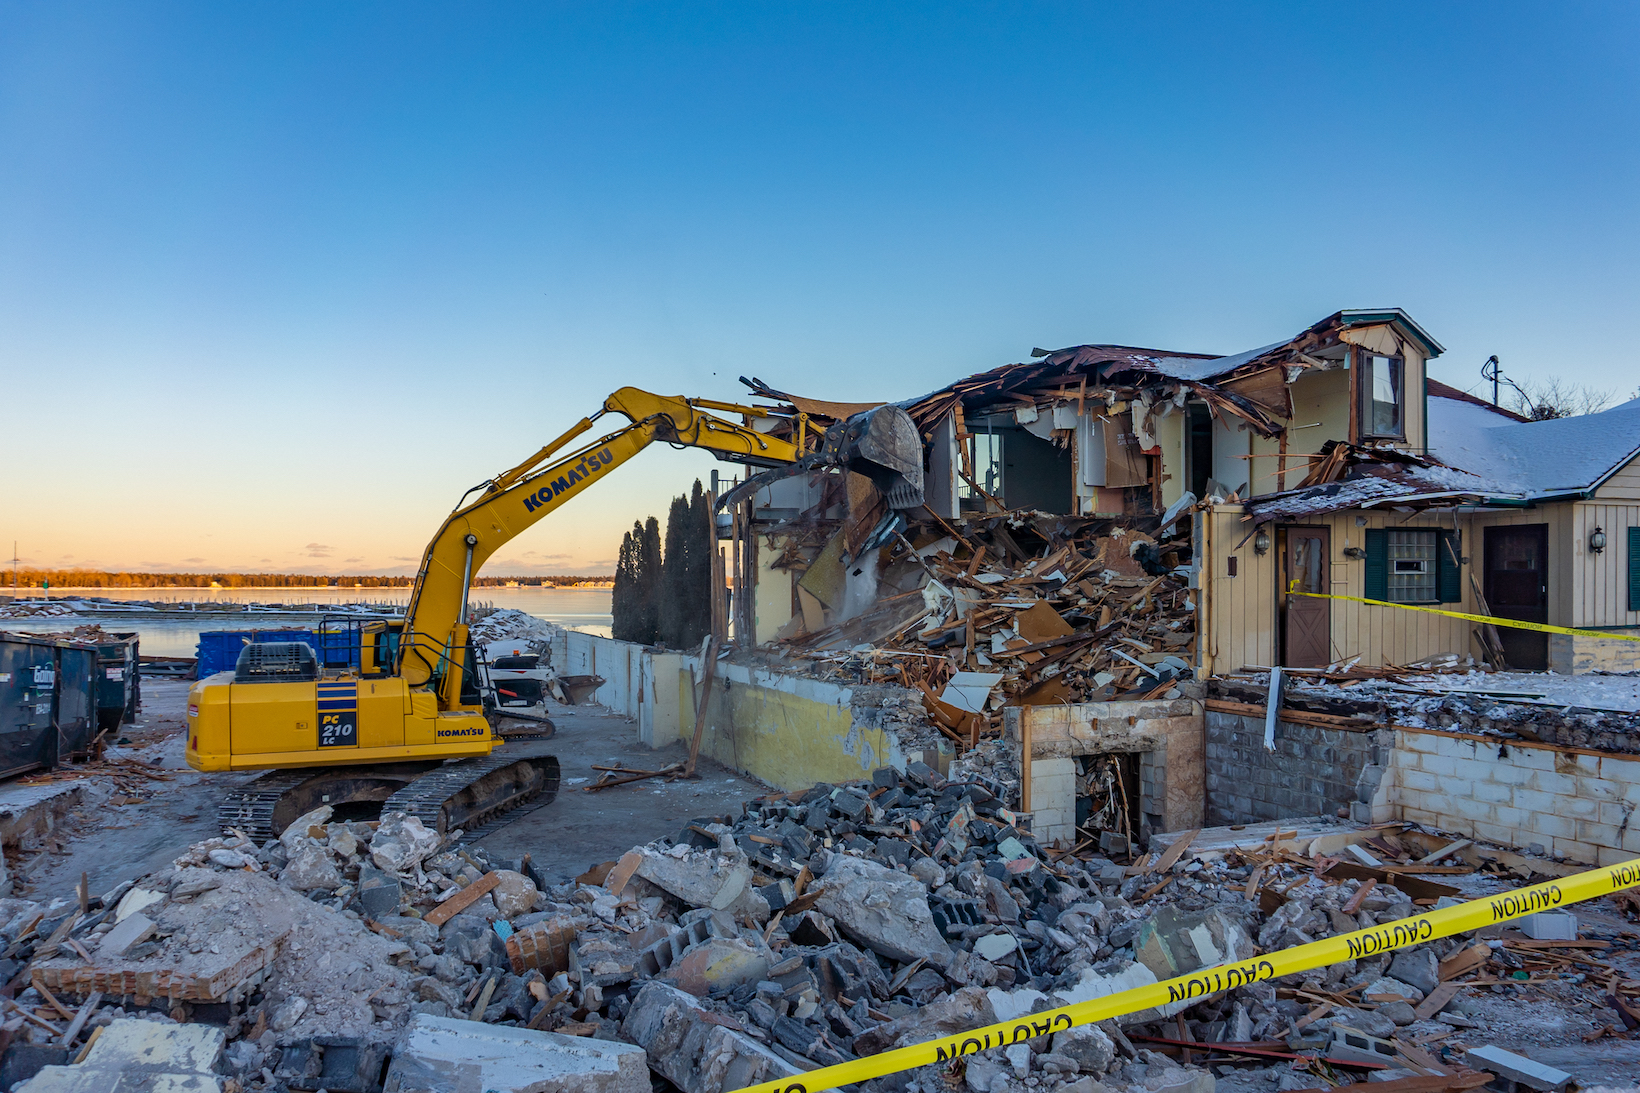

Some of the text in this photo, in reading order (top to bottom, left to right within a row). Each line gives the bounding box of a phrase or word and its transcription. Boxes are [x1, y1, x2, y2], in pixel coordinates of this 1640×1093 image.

[523, 447, 613, 513] KOMATSU
[322, 715, 339, 724] PC
[322, 724, 353, 737] 210
[438, 727, 484, 737] KOMATSU
[323, 737, 335, 745] LC
[1490, 885, 1562, 920] CAUTION
[1346, 919, 1432, 959] CAUTION
